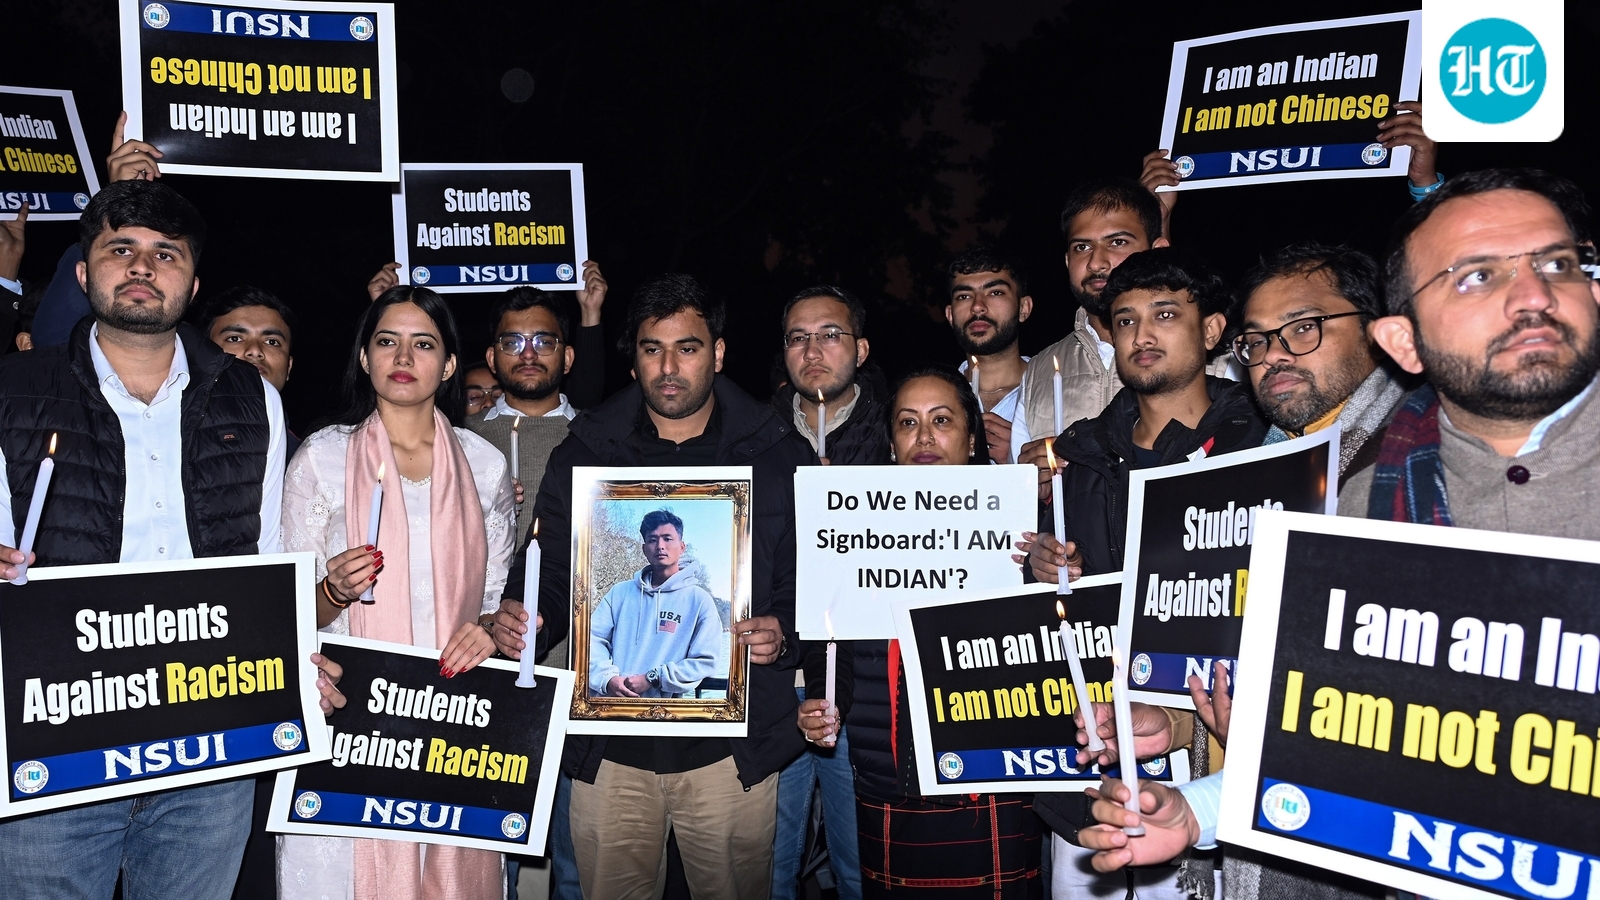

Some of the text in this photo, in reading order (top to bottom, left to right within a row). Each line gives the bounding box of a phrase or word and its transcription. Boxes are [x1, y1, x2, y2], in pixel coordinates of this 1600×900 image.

[212, 10, 310, 38] NSUI
[151, 57, 371, 99] I am not Chinese
[1203, 52, 1378, 94] I am an Indian
[0, 113, 57, 139] Indian
[170, 103, 356, 144] I am an Indian
[1182, 93, 1389, 133] I am not Chinese
[4, 147, 77, 174] Chinese
[1229, 146, 1322, 173] NSUI
[0, 192, 50, 210] SUI
[444, 187, 531, 212] Students
[417, 220, 565, 248] Against Racism
[459, 265, 529, 283] NSUI
[827, 489, 1000, 511] Do We Need a
[967, 529, 1011, 551] AM
[858, 567, 968, 590] INDIAN'?
[1143, 571, 1232, 622] Against
[75, 602, 229, 652] Students
[660, 611, 682, 624] USA
[1324, 588, 1347, 651] I
[1353, 603, 1440, 667] am
[1447, 616, 1525, 682] an
[940, 636, 953, 671] I
[956, 636, 999, 670] am
[1002, 632, 1038, 666] an
[22, 655, 285, 725] Against Racism
[367, 677, 492, 728] Students
[933, 687, 945, 723] I
[948, 689, 991, 722] am
[993, 682, 1040, 719] not
[1281, 670, 1304, 733] I
[1310, 686, 1394, 753] am
[1402, 703, 1500, 776] not
[103, 733, 228, 780] NSUI
[326, 726, 424, 768] gainst
[425, 737, 529, 785] Racism
[1002, 748, 1101, 776] NSU
[361, 797, 464, 831] NSUI
